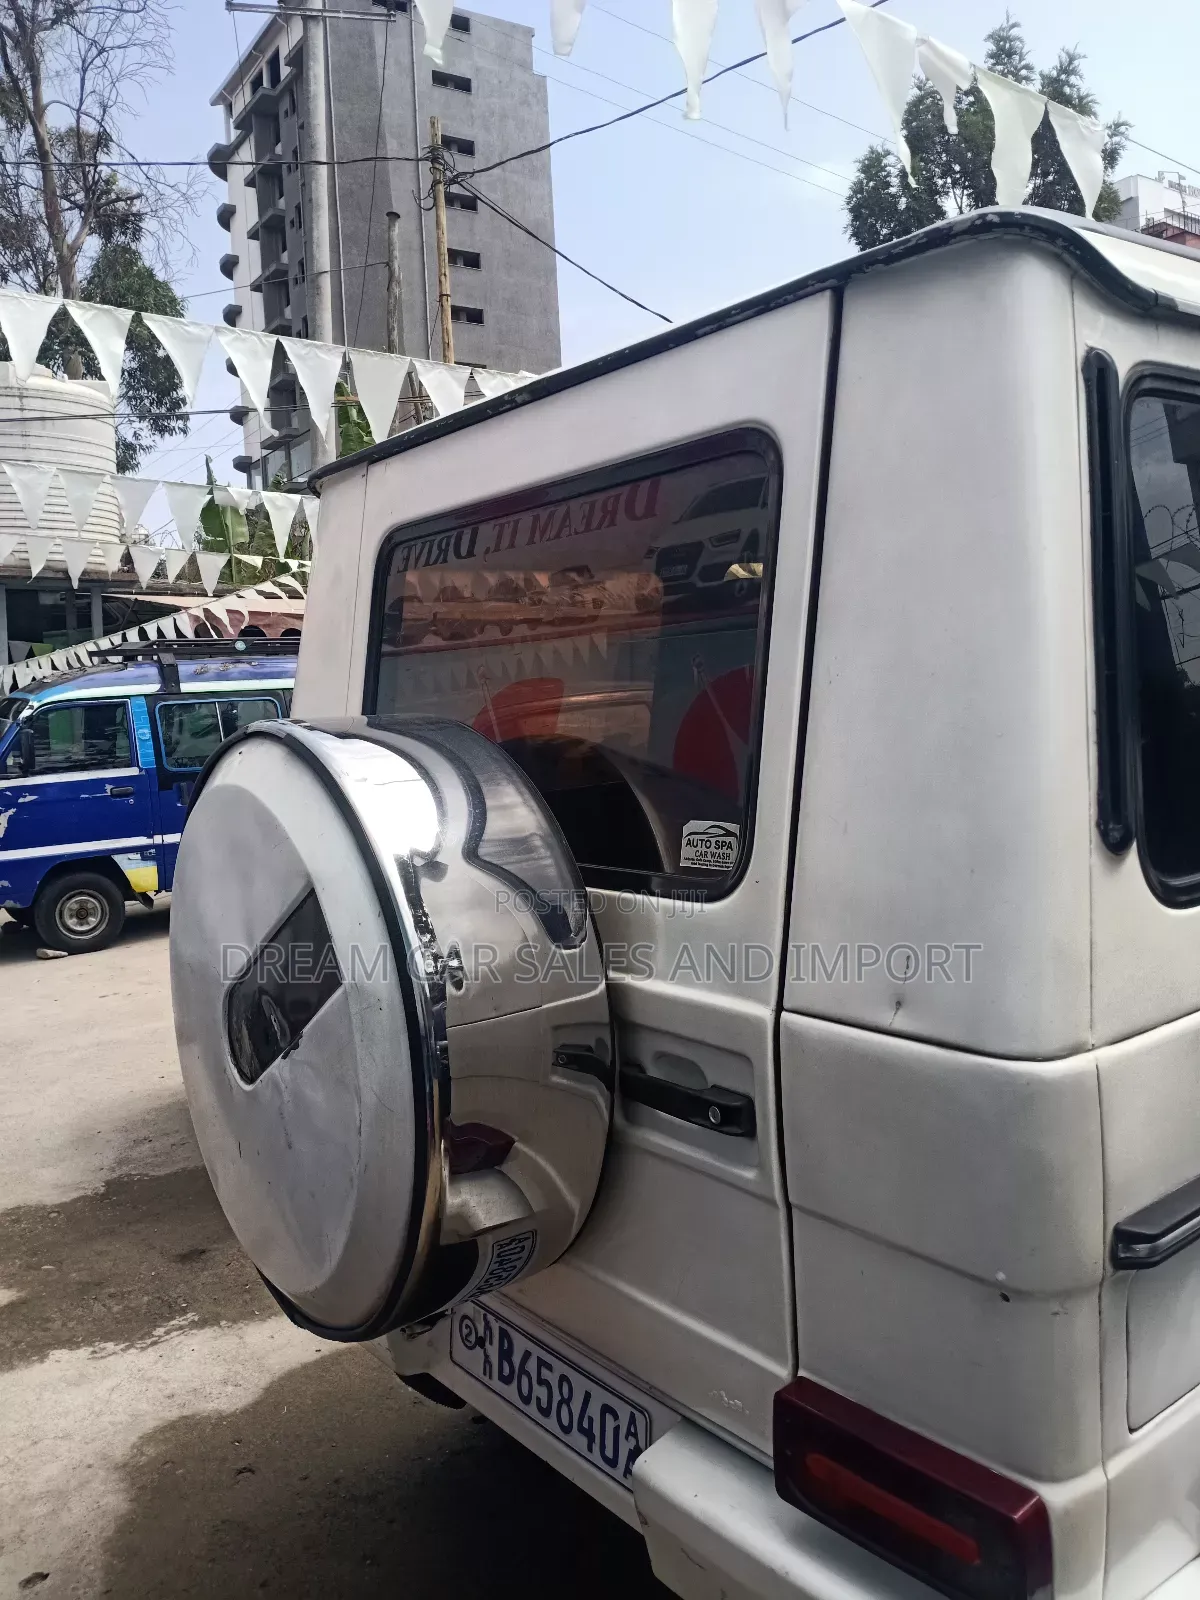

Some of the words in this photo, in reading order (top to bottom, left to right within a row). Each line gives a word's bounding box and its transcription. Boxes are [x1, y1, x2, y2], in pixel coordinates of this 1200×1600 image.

[685, 838, 712, 849] AUTO
[714, 840, 733, 851] SPA
[695, 850, 708, 859] CAR
[710, 851, 731, 860] WASH
[498, 1326, 621, 1469] B65840
